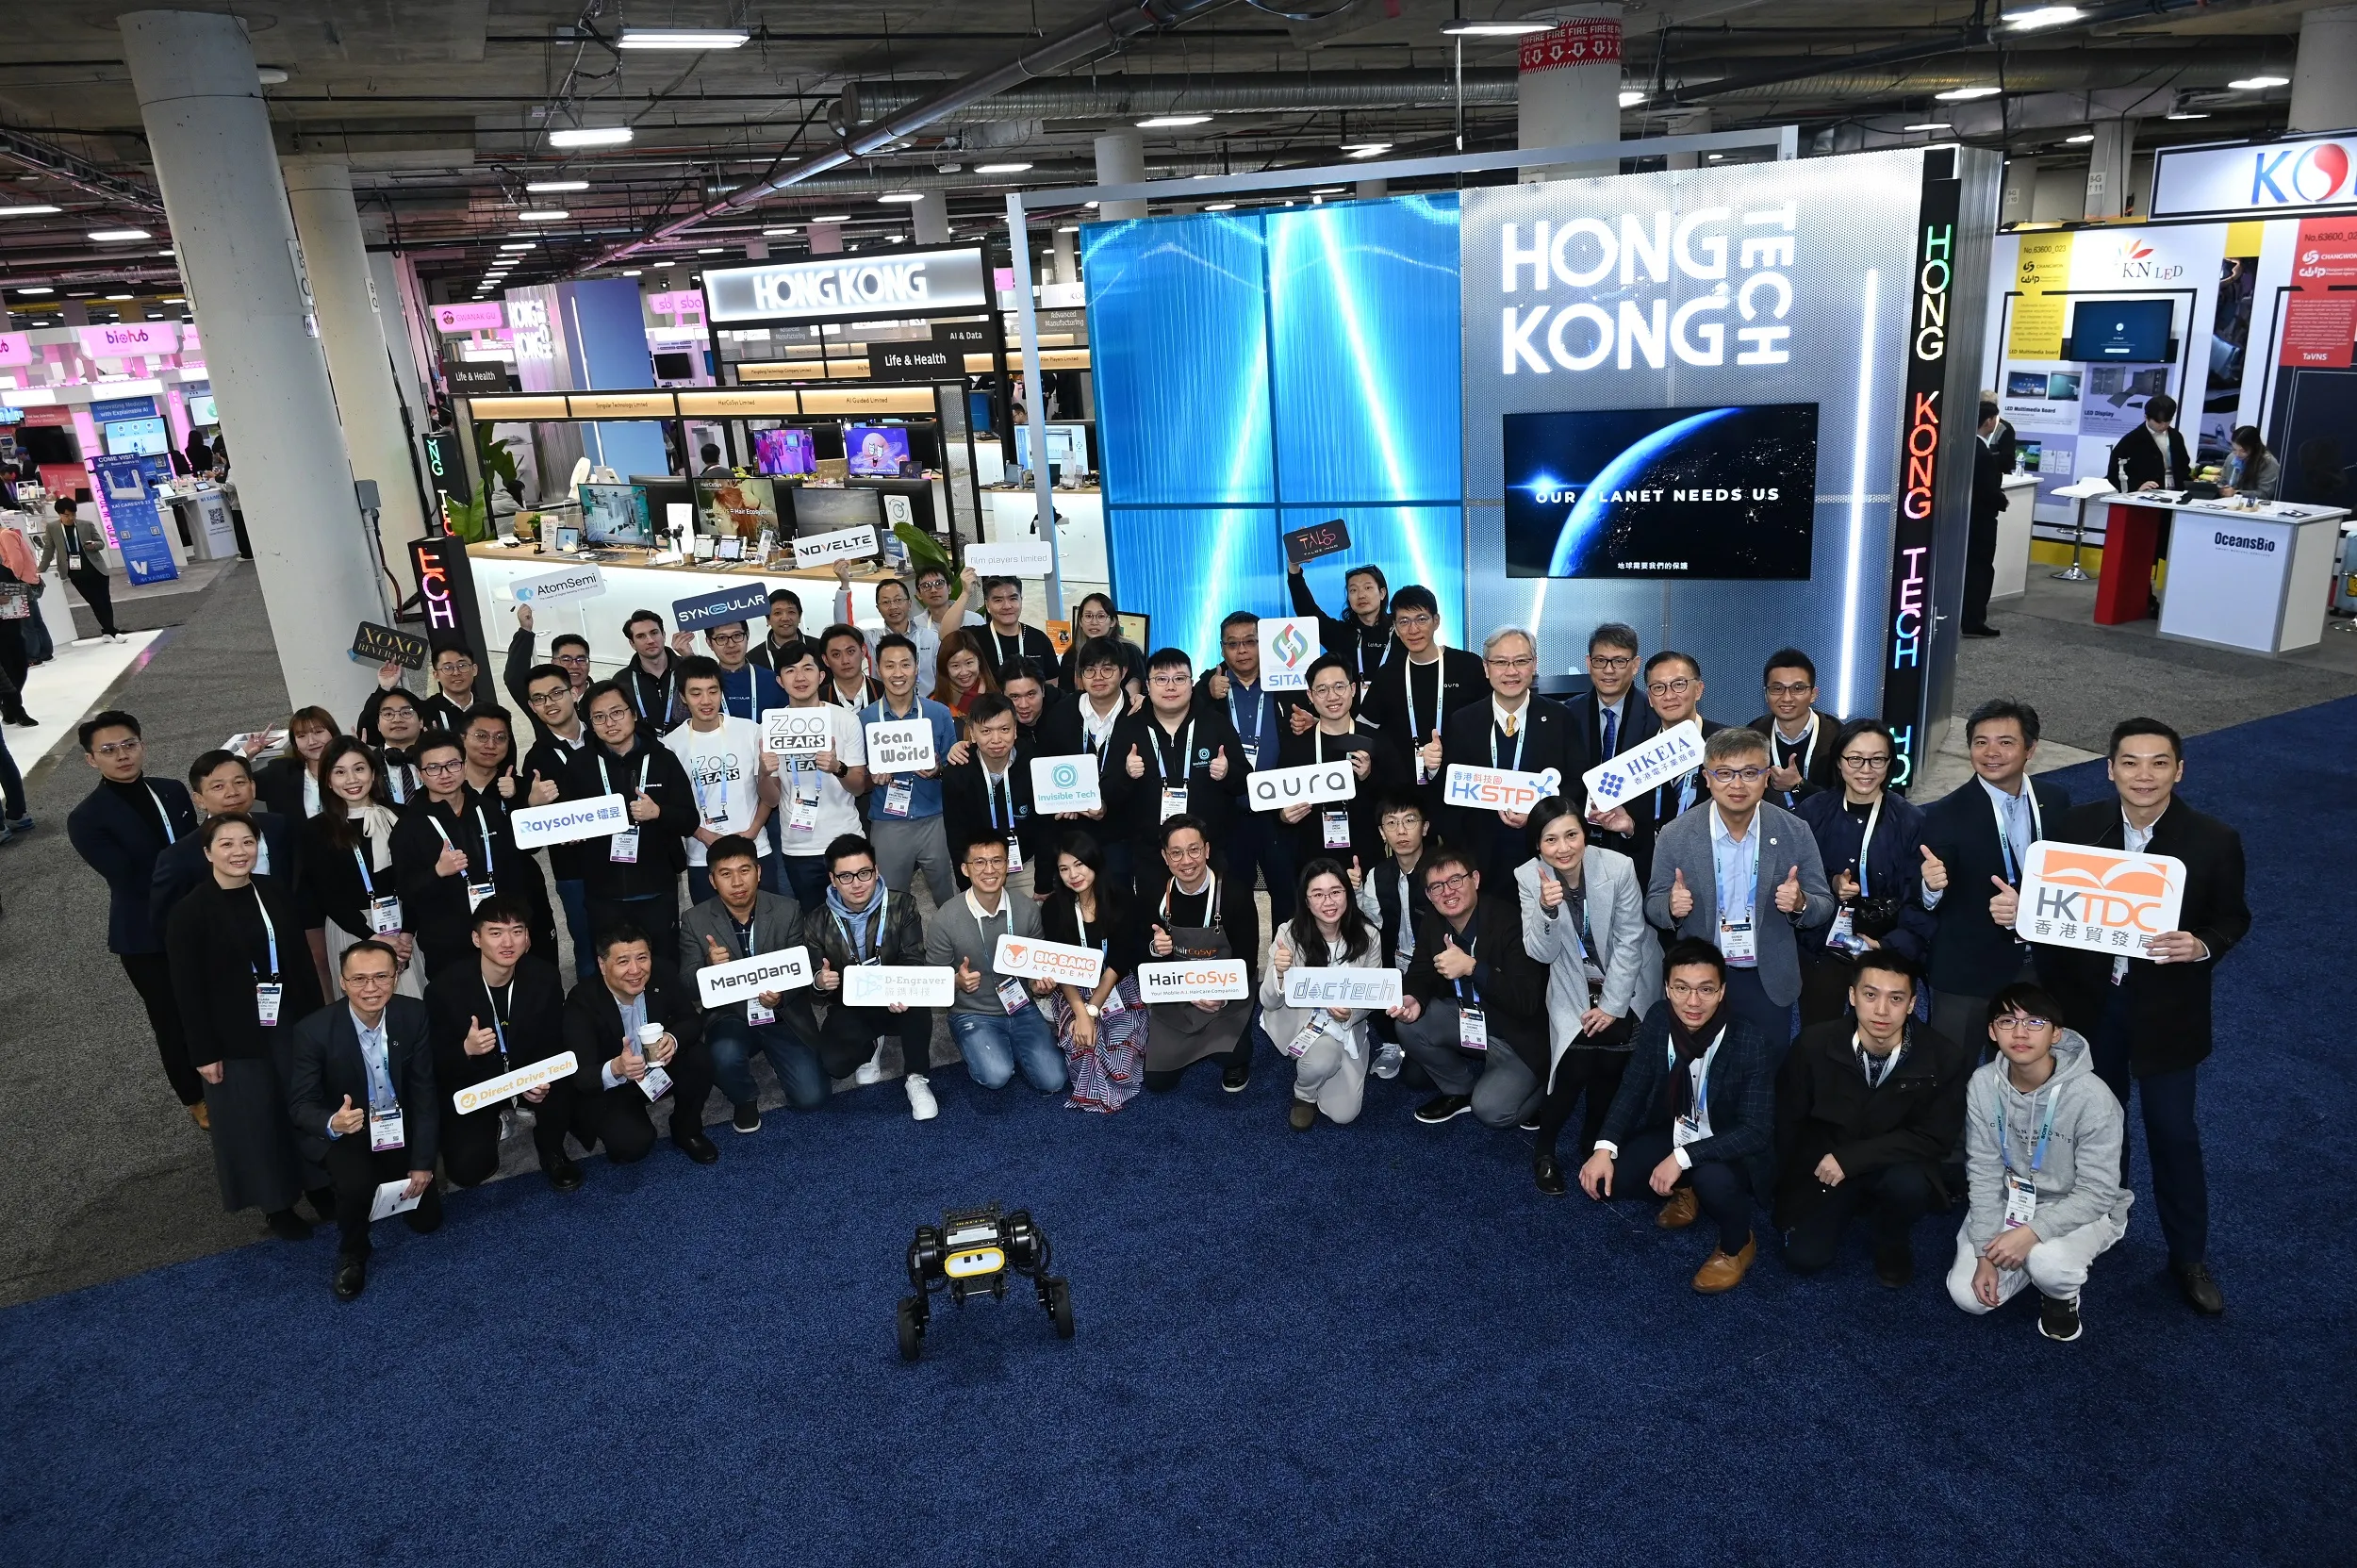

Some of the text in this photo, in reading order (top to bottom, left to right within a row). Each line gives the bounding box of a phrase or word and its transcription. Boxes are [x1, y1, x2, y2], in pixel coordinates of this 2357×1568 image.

[1547, 29, 1565, 40] FIRE
[1569, 26, 1588, 36] FIRE
[1591, 25, 1607, 33] FIRE
[2251, 143, 2357, 206] KO
[1502, 206, 1729, 293] HONG
[2122, 261, 2183, 280] KN LED
[753, 263, 927, 311] HONG KONG
[1737, 200, 1799, 366] TECH
[681, 295, 702, 309] sba
[456, 313, 485, 322] GWANAK
[1046, 318, 1084, 327] Manufacturing
[1051, 310, 1077, 319] Advanced
[966, 331, 982, 339] Data
[1503, 294, 1728, 374] KONG
[884, 352, 947, 367] Life & Health
[455, 372, 468, 382] Life
[474, 371, 495, 381] Health
[97, 403, 124, 411] Innovating
[112, 407, 140, 417] Explainable
[1894, 224, 1952, 669] HONG KONG TECH
[119, 454, 135, 462] VISIT
[1535, 488, 1779, 504] OUR LANET NEEDS US
[799, 535, 872, 556] NOVELTE
[2215, 532, 2275, 552] OceansBio
[988, 555, 1018, 564] players
[1020, 554, 1047, 563] limited
[537, 573, 598, 596] AtomSemi
[363, 627, 422, 655] XOXO
[1269, 674, 1307, 686] SITA
[770, 734, 826, 750] GEARS
[873, 731, 913, 746] Scan
[880, 746, 930, 763] World
[1625, 736, 1690, 777] HKEIA
[1634, 750, 1696, 785] 香港電子業商會
[1256, 771, 1345, 800] aura
[1451, 782, 1534, 805] HKSTP
[1038, 790, 1096, 801] Invisible Tech
[520, 811, 595, 834] Raysolve
[2036, 886, 2162, 933] HKTDC
[1033, 949, 1096, 971] BIG BANG
[710, 962, 801, 991] MangDang
[1032, 965, 1095, 979] ACADEMY
[1148, 970, 1238, 987] HairCoSys
[884, 976, 947, 986] D-Engraver
[480, 1061, 572, 1101] Direct Drive Tech
